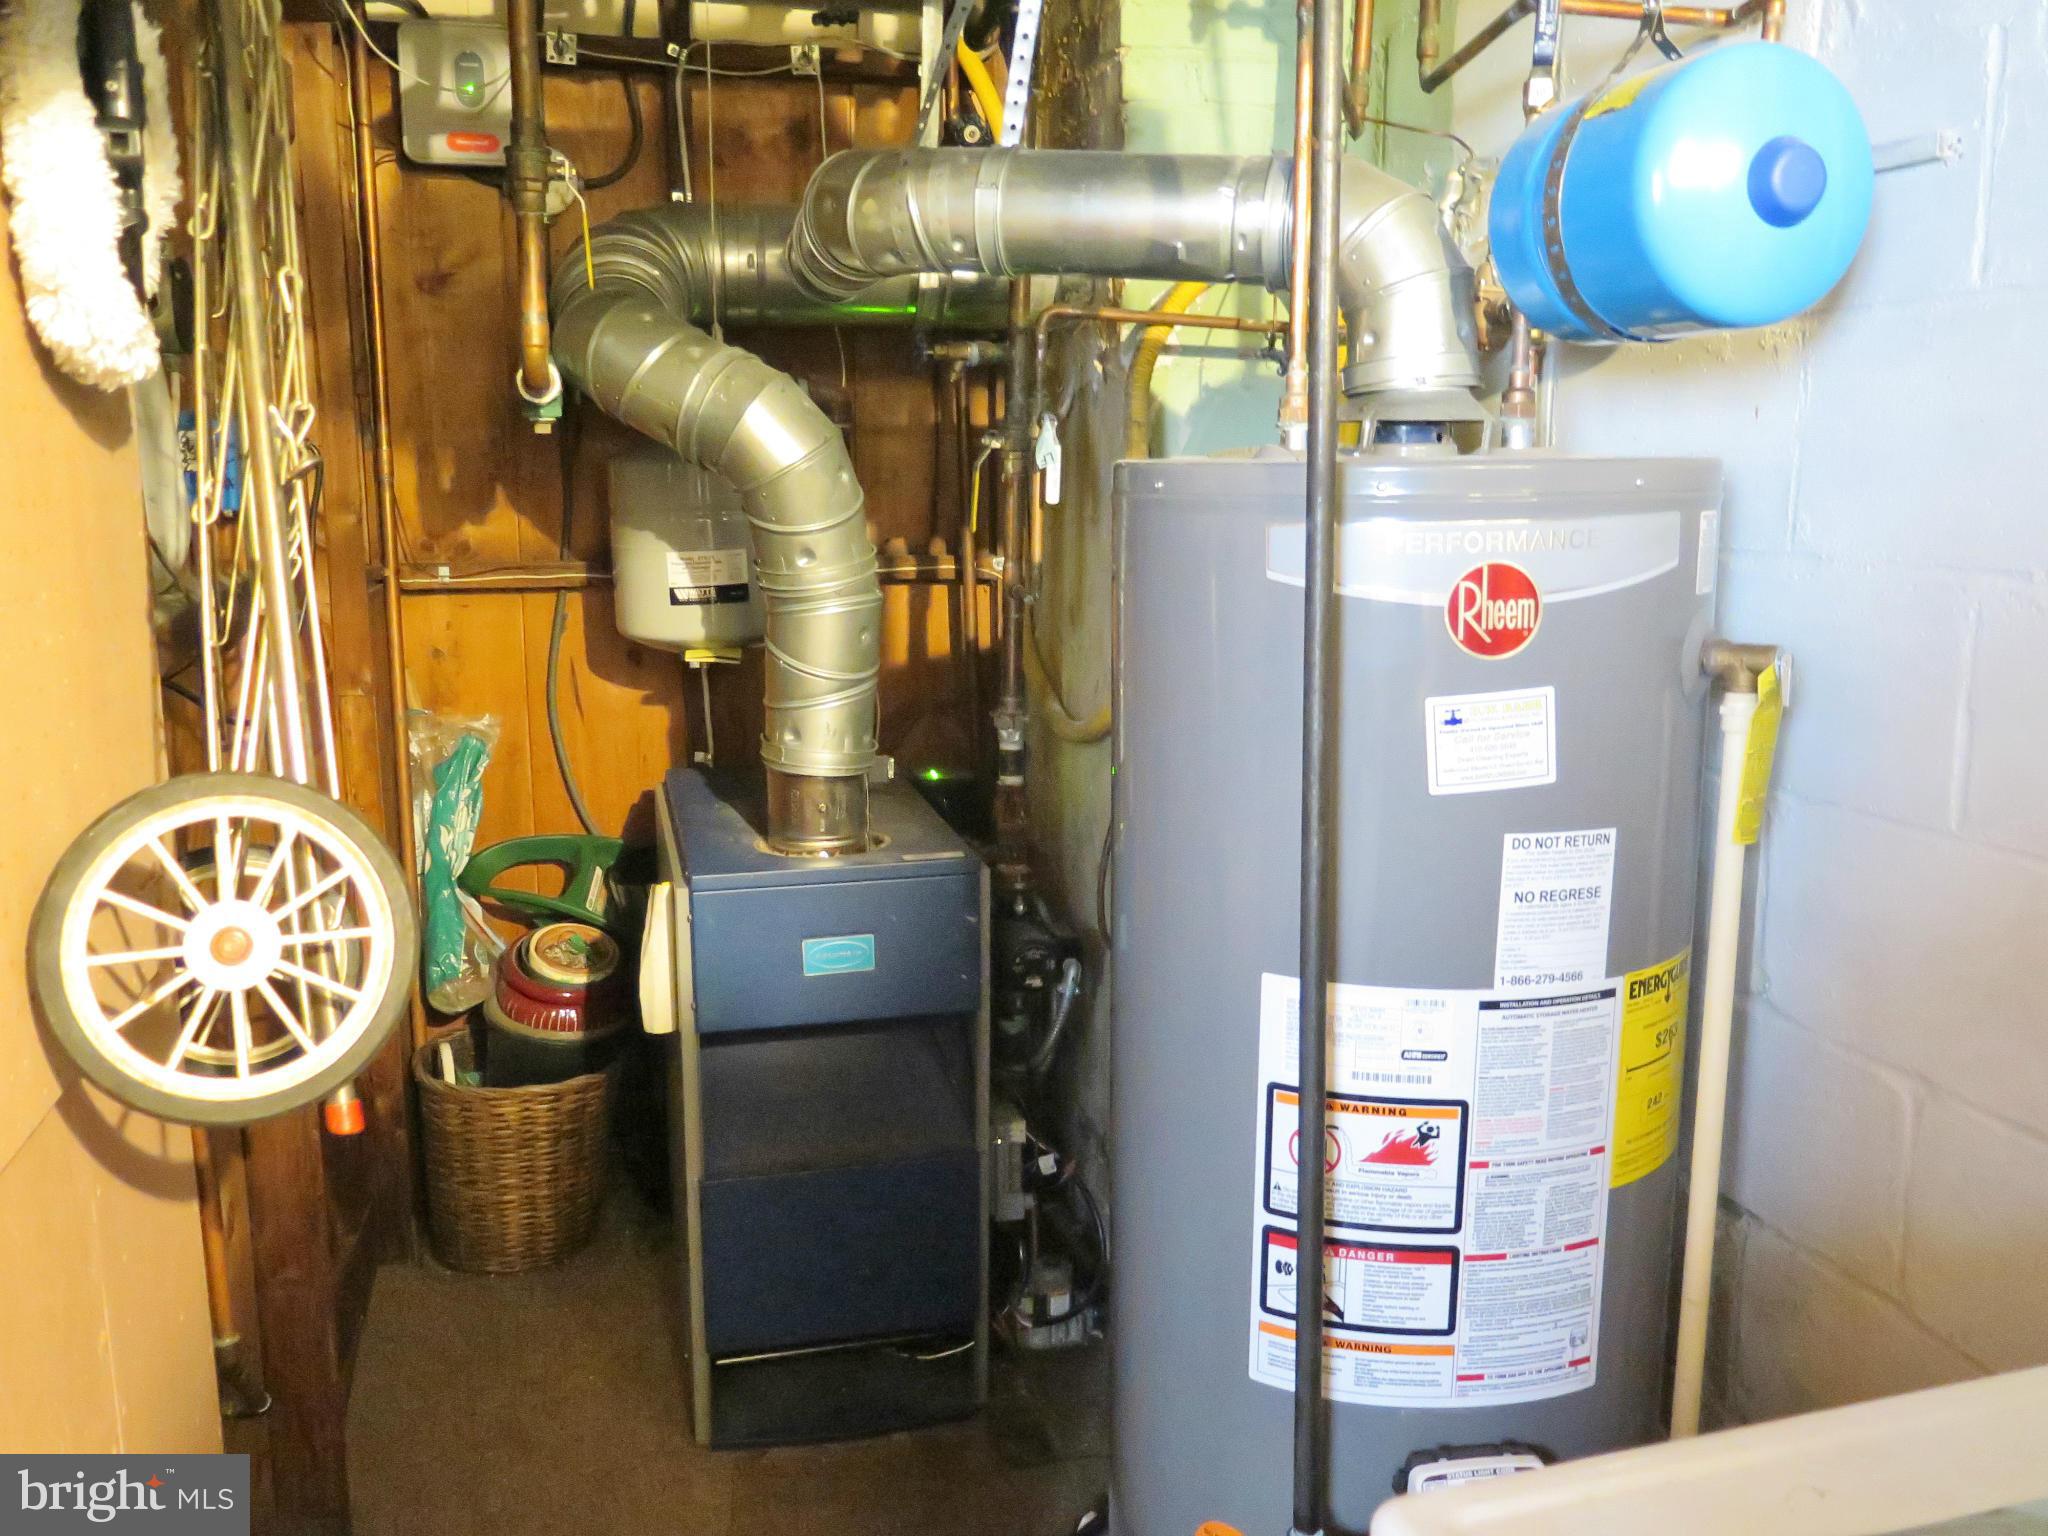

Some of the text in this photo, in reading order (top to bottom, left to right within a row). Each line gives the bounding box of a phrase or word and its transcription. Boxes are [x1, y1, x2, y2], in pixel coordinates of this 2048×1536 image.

[1385, 527, 1599, 554] PERFORMANCE
[1457, 564, 1536, 643] Rheem
[1454, 734, 1474, 745] Call
[1494, 731, 1531, 741] Service
[1511, 832, 1611, 850] DO NOT RETURN
[1514, 886, 1602, 904] NO REGRESE
[1500, 970, 1583, 986] 1-866-279-4566
[1499, 999, 1539, 1009] INSTALLATION
[1502, 1012, 1535, 1020] AUTOMATIC
[1340, 1103, 1407, 1117] WARNING
[1358, 1167, 1420, 1178] Flammable Vapors
[1339, 1248, 1394, 1262] DANGER
[1335, 1340, 1392, 1354] WARNING
